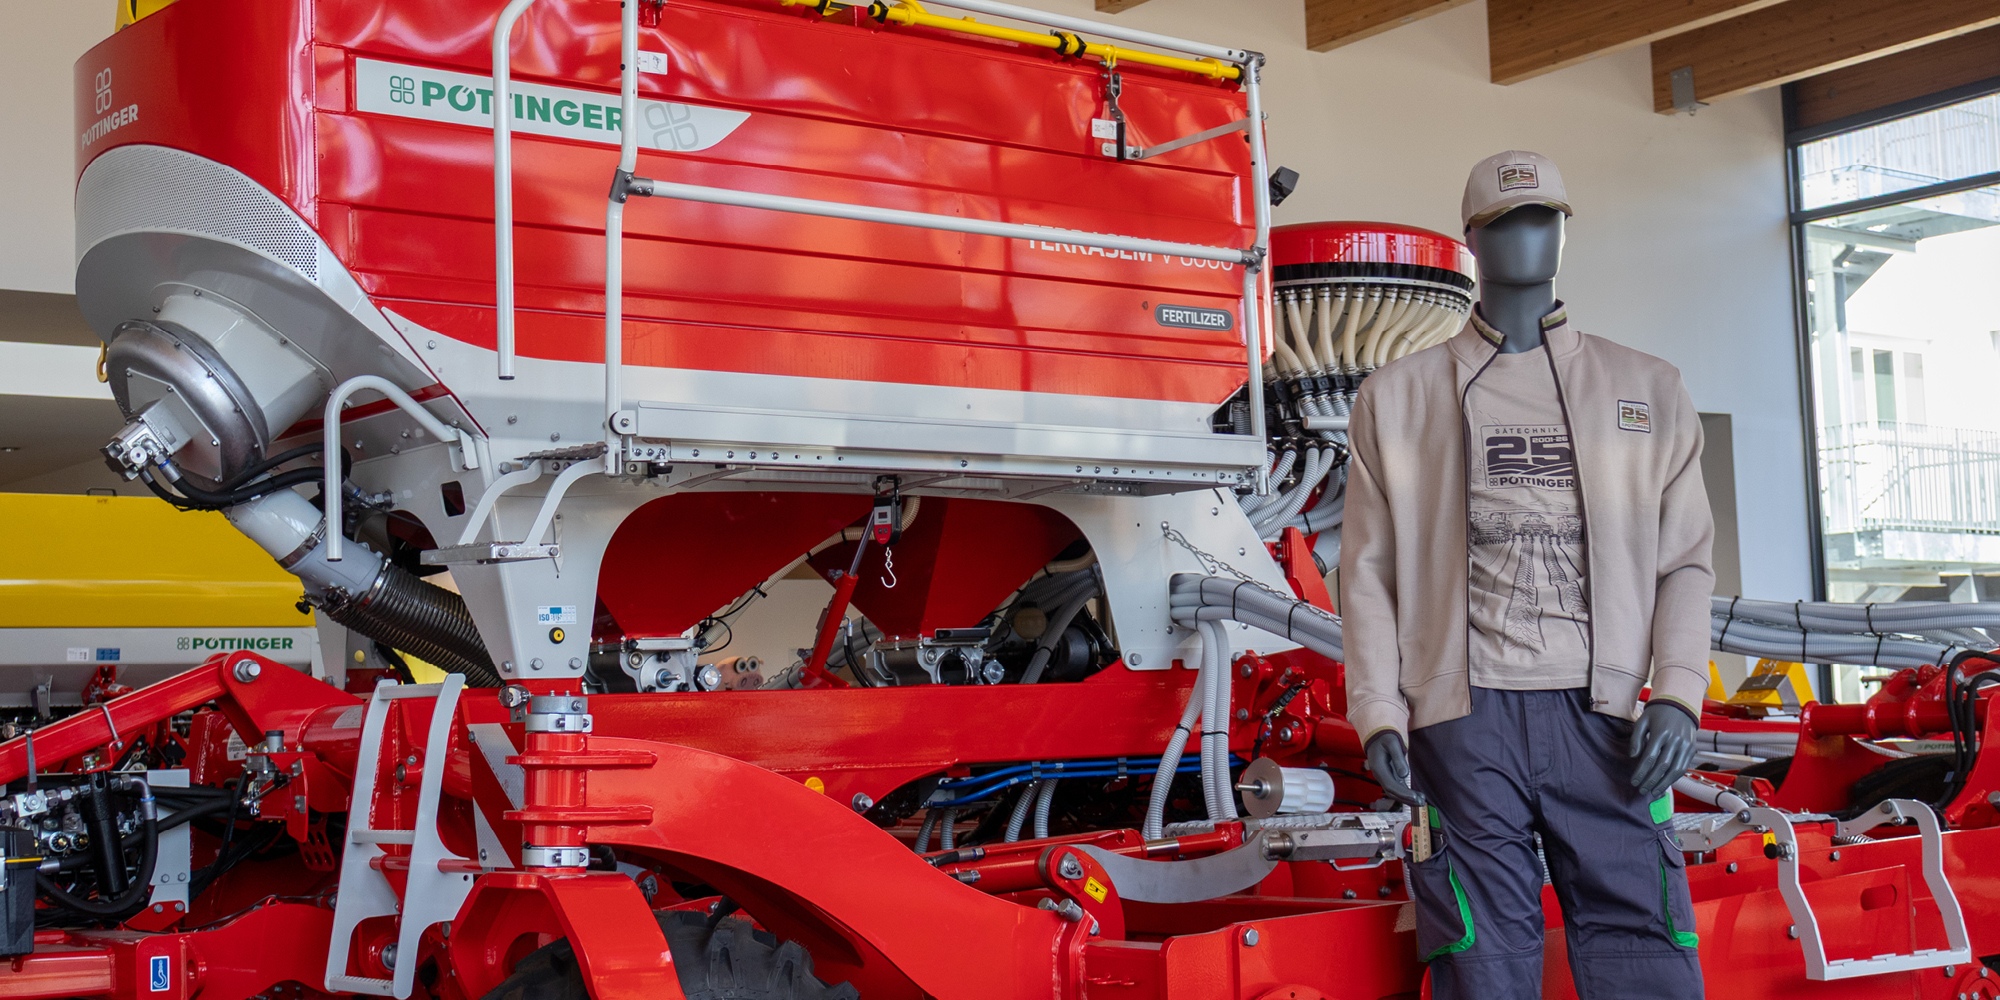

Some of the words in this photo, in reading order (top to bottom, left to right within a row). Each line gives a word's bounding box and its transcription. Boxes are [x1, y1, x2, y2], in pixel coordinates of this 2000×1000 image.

[421, 80, 622, 132] PÖTINGER
[1501, 168, 1535, 182] 25
[1162, 309, 1226, 327] FERTILIZER
[1621, 406, 1648, 420] 25
[1486, 435, 1572, 472] 25
[1500, 476, 1575, 488] PÖTTINGER
[192, 637, 294, 650] PÖTTINGER
